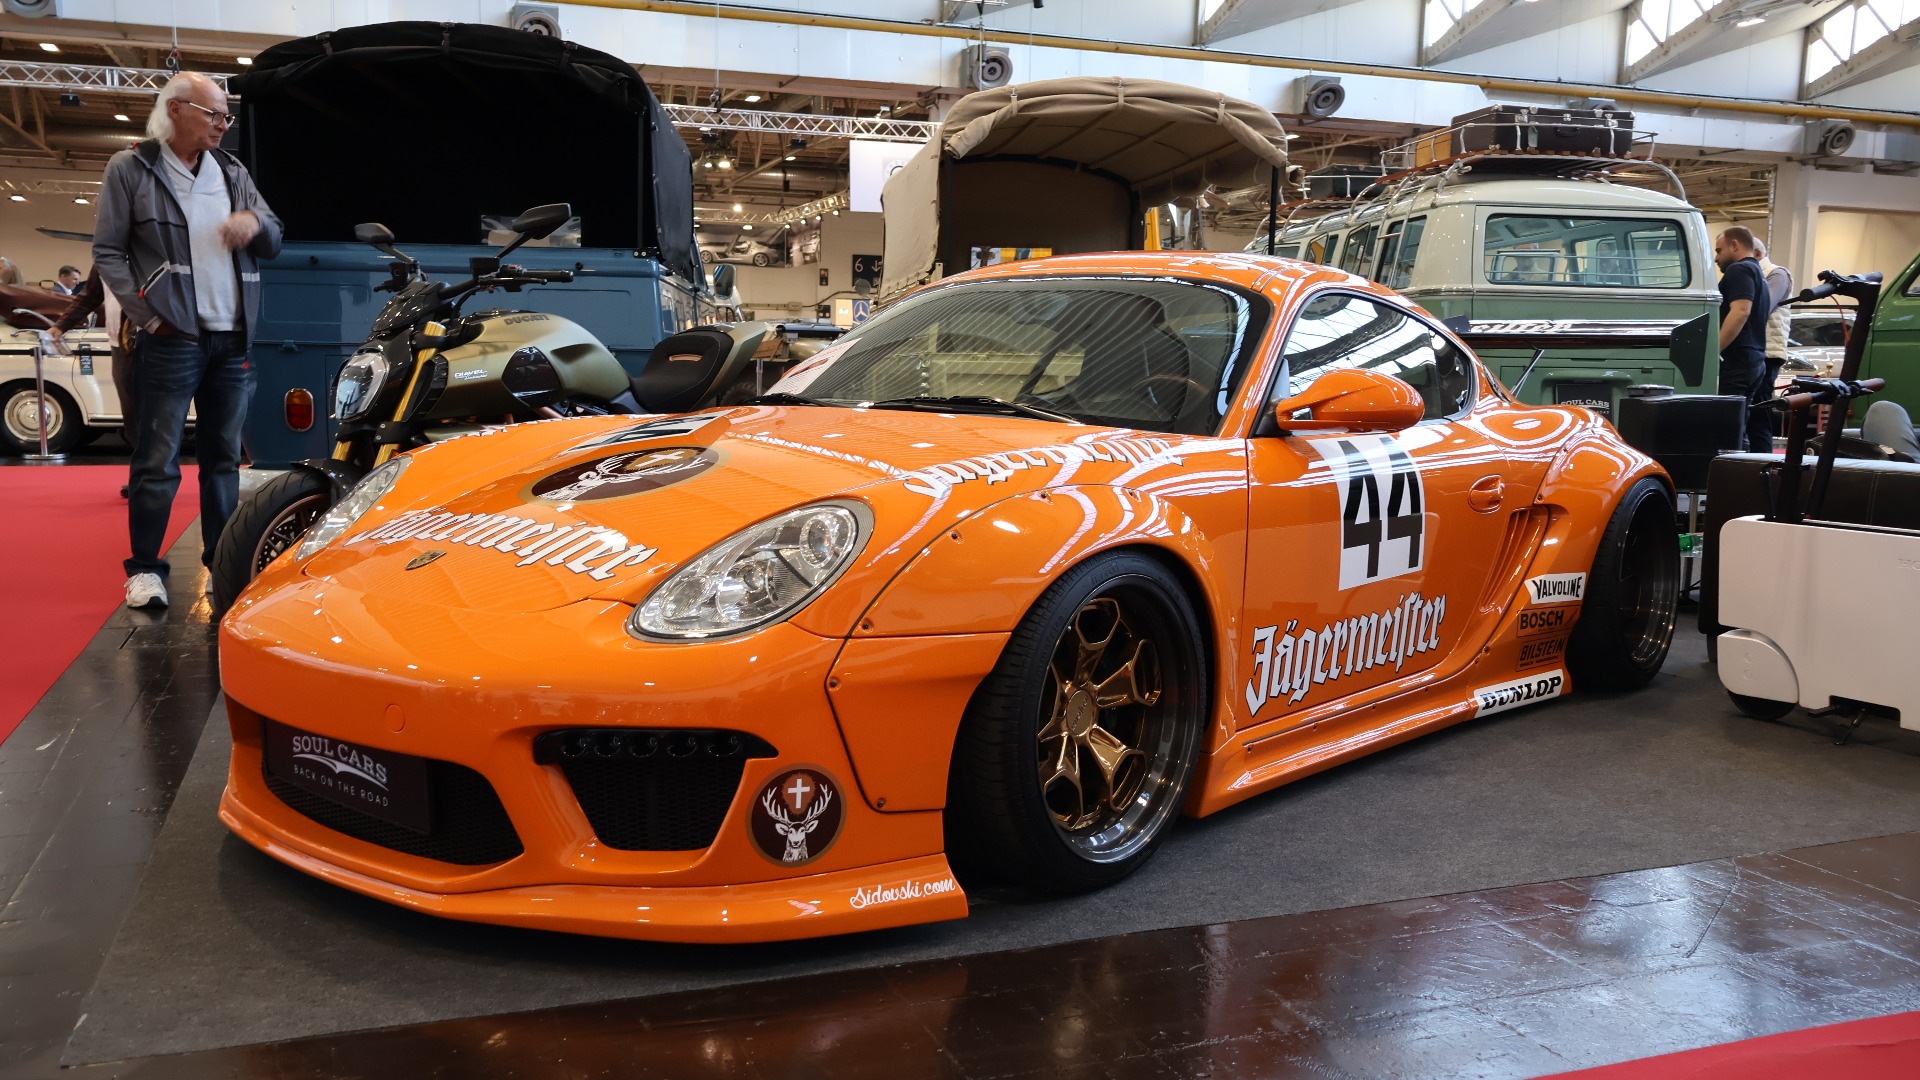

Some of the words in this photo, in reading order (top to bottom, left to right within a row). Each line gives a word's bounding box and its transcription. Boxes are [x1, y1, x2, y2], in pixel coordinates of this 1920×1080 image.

[854, 257, 864, 273] 6
[504, 314, 549, 325] DUCATI
[1586, 399, 1610, 408] CARS
[1336, 437, 1423, 579] 44
[1531, 575, 1583, 600] VALVOLINE
[1520, 609, 1565, 630] BOSCH
[1520, 636, 1568, 661] BILSTEIN
[1480, 675, 1562, 711] DUNLOP
[292, 736, 334, 757] SOUL
[337, 743, 387, 784] CARS
[293, 764, 317, 781] BACK
[320, 774, 333, 787] ON
[337, 780, 356, 796] THE
[360, 788, 389, 807] ROAD
[849, 877, 956, 909] Sidovski.com
